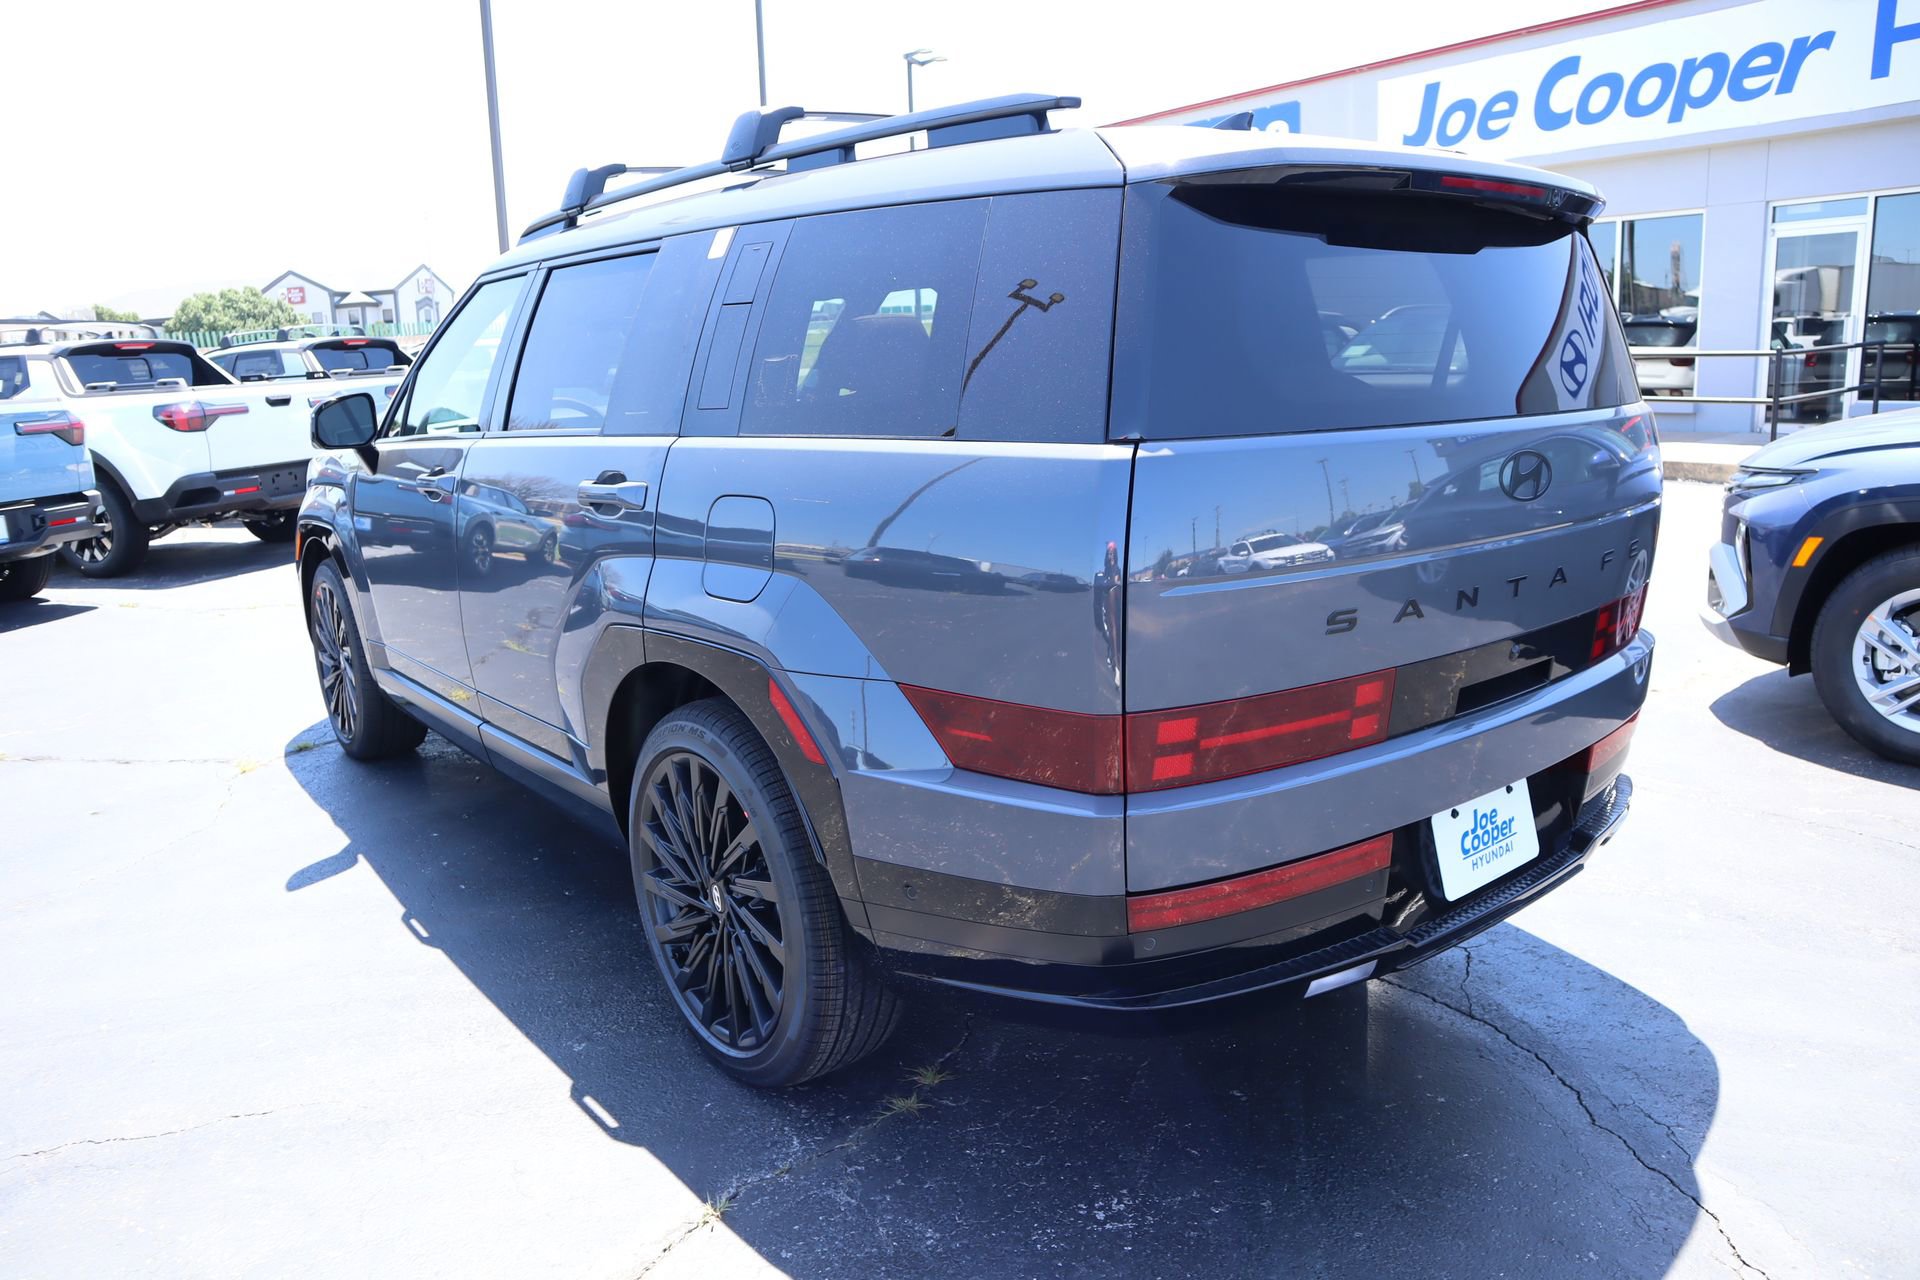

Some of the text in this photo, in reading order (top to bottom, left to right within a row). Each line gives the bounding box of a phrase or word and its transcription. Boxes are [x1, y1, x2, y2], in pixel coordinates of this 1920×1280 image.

[1403, 81, 1518, 147] Joe
[1533, 31, 1837, 131] Cooper
[1325, 539, 1639, 635] SANTA FE
[1461, 816, 1515, 856] Cooper
[1470, 808, 1498, 835] Joe
[1472, 840, 1514, 872] HYUNDAI
